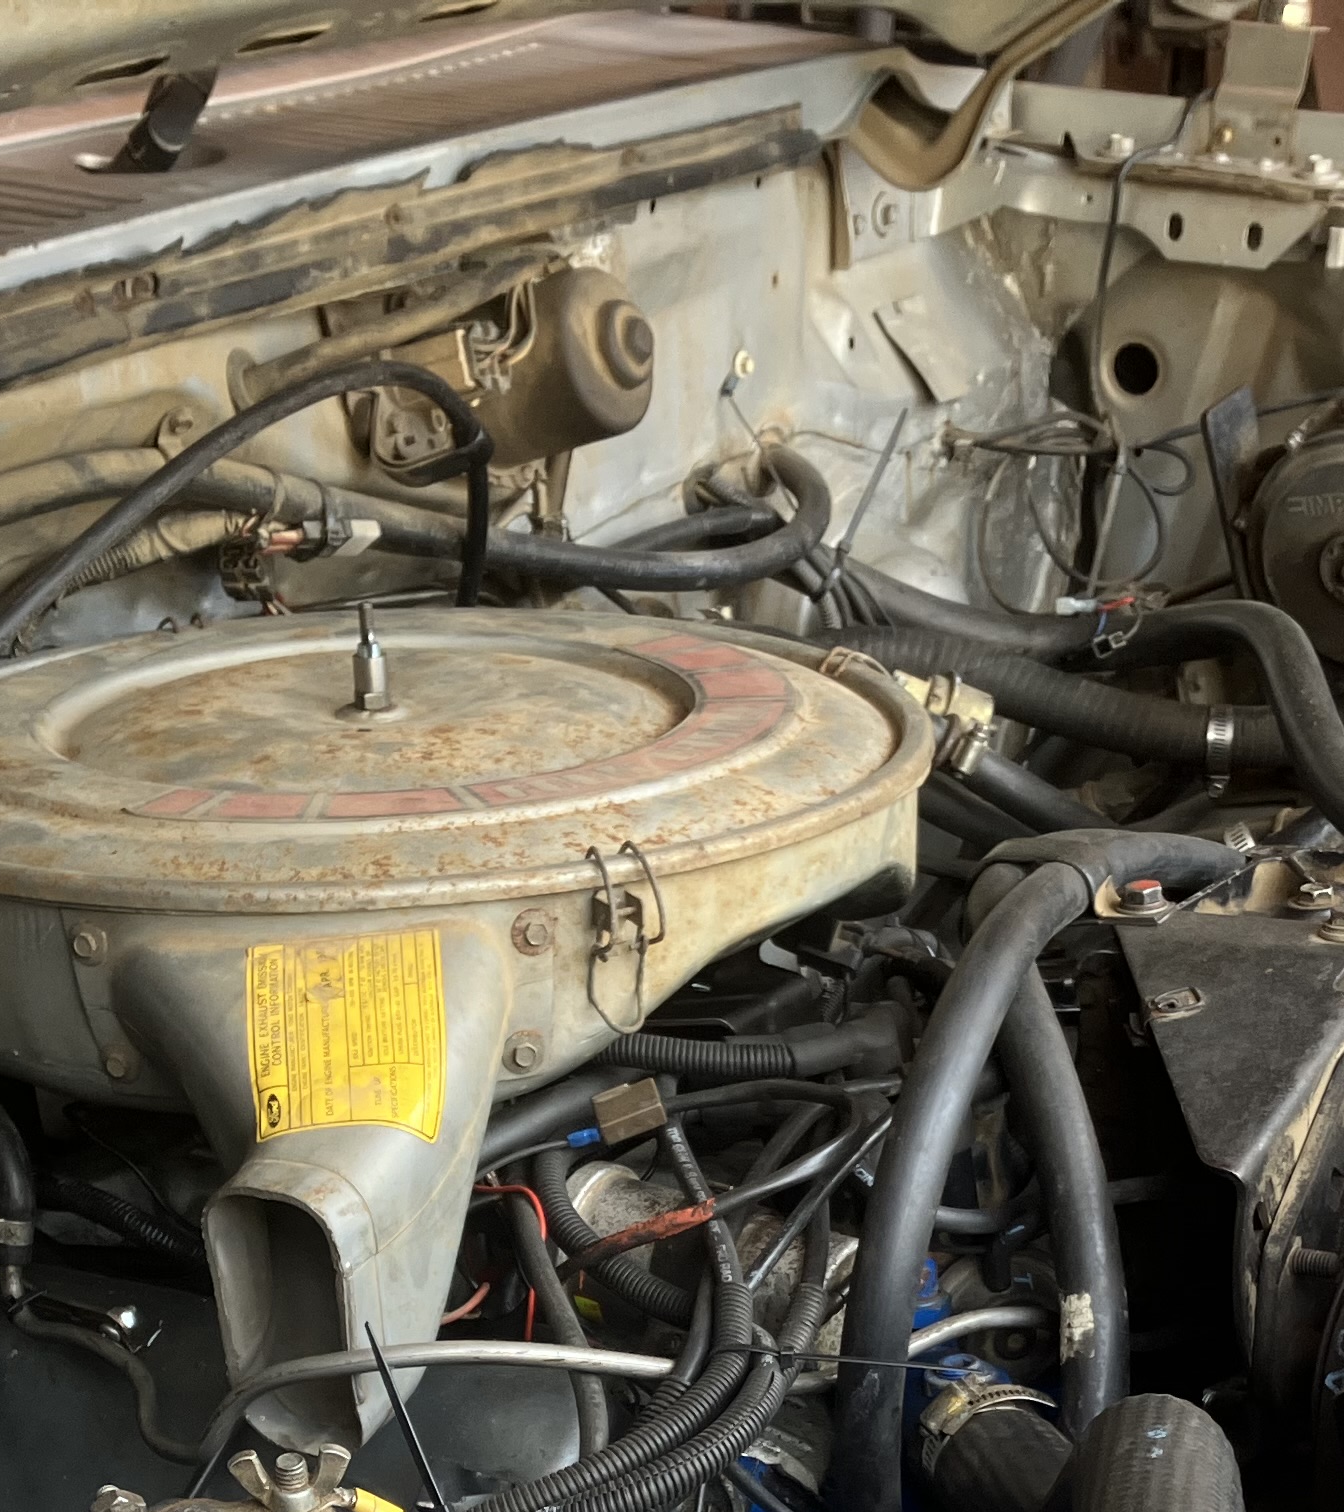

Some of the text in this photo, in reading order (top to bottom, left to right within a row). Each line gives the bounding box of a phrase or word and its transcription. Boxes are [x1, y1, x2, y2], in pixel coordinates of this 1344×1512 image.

[256, 992, 270, 1076] ENGINE EXHAUST
[269, 1019, 282, 1065] CONTROL
[322, 1058, 332, 1084] ENGINE
[325, 1097, 334, 1115] DATE
